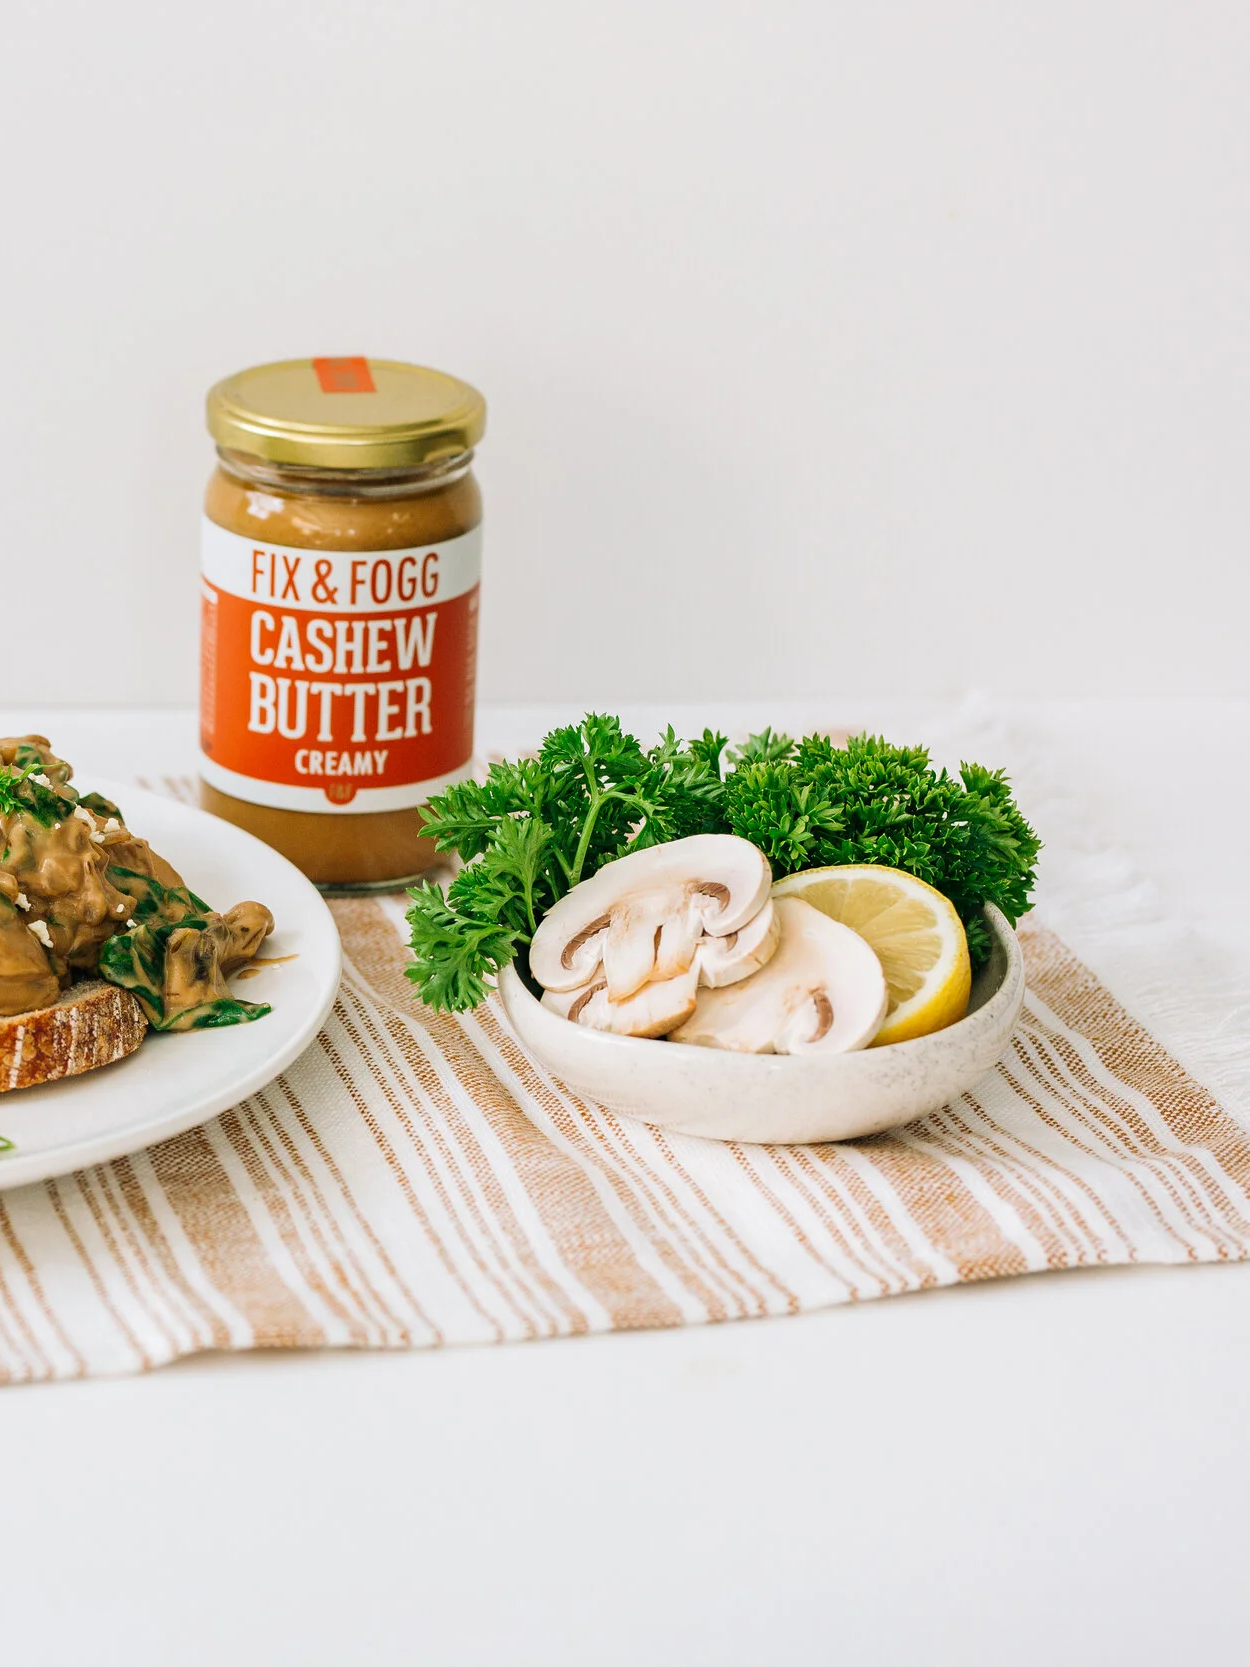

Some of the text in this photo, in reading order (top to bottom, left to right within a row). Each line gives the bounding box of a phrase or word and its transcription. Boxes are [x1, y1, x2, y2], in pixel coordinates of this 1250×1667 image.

[252, 550, 439, 605] FIX & FOGG
[250, 610, 438, 674] CASHEW
[248, 671, 432, 742] BUTTER
[294, 749, 389, 776] CREAMY
